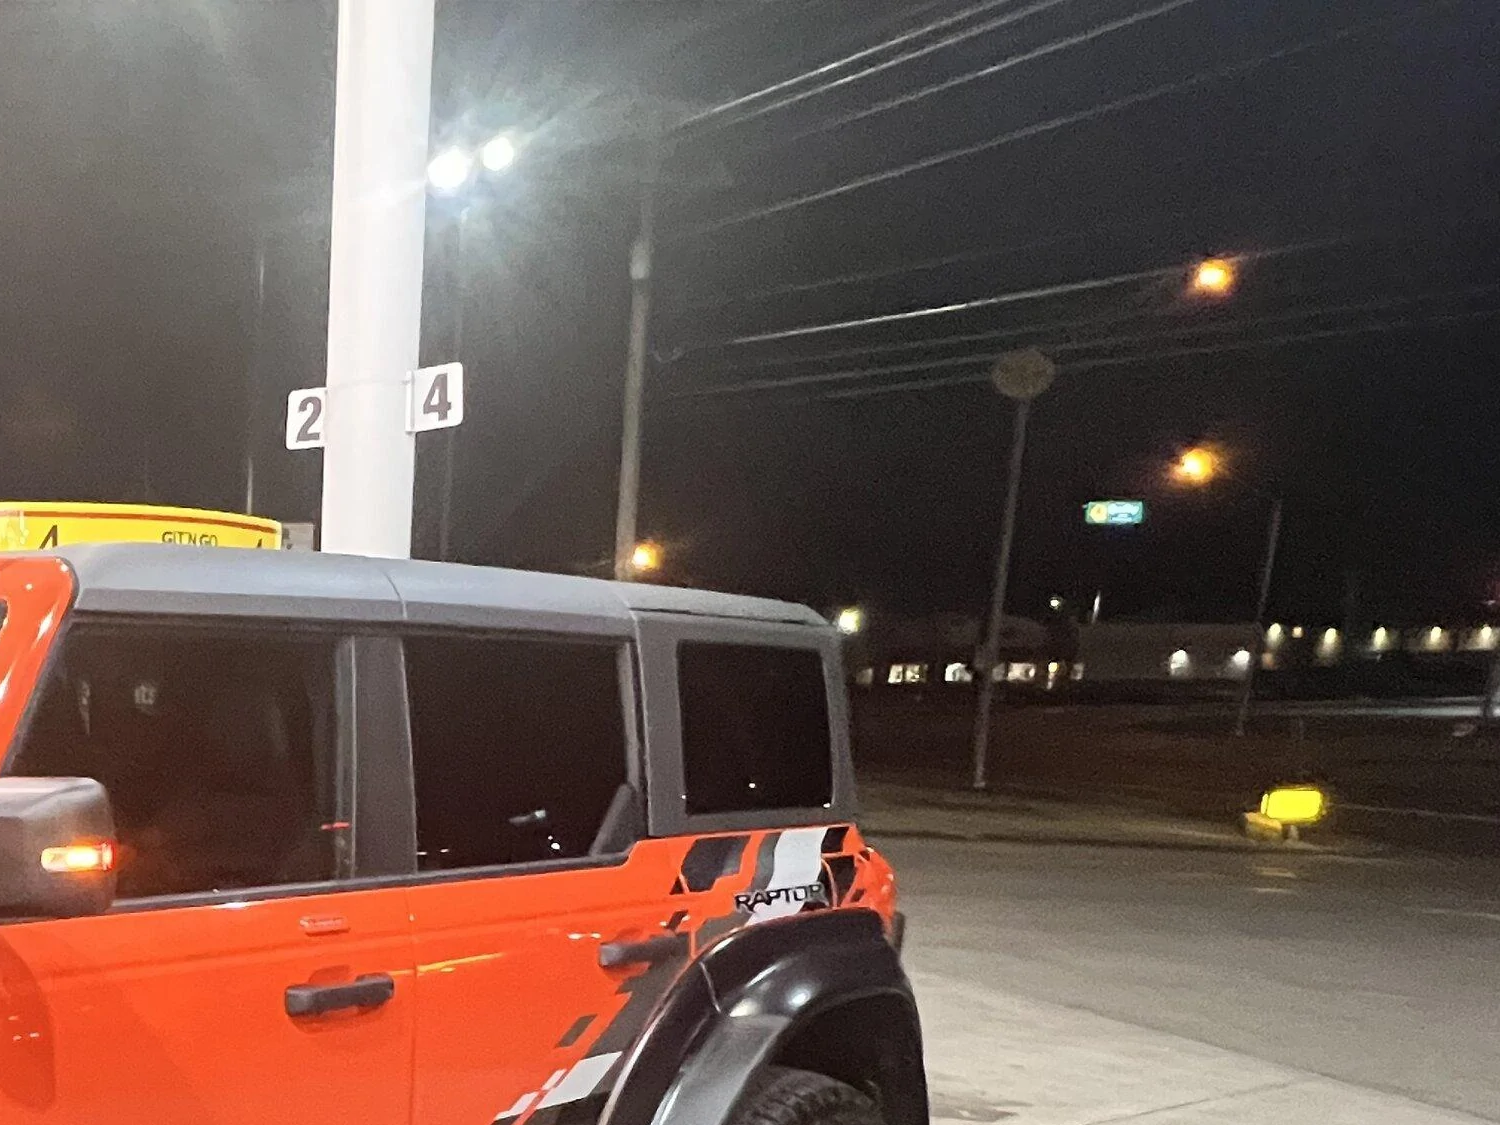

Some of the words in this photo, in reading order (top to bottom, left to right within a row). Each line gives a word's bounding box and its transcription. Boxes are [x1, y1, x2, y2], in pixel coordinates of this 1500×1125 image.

[296, 396, 322, 443] 2
[423, 372, 452, 422] 4
[734, 882, 829, 914] RAPTOR
